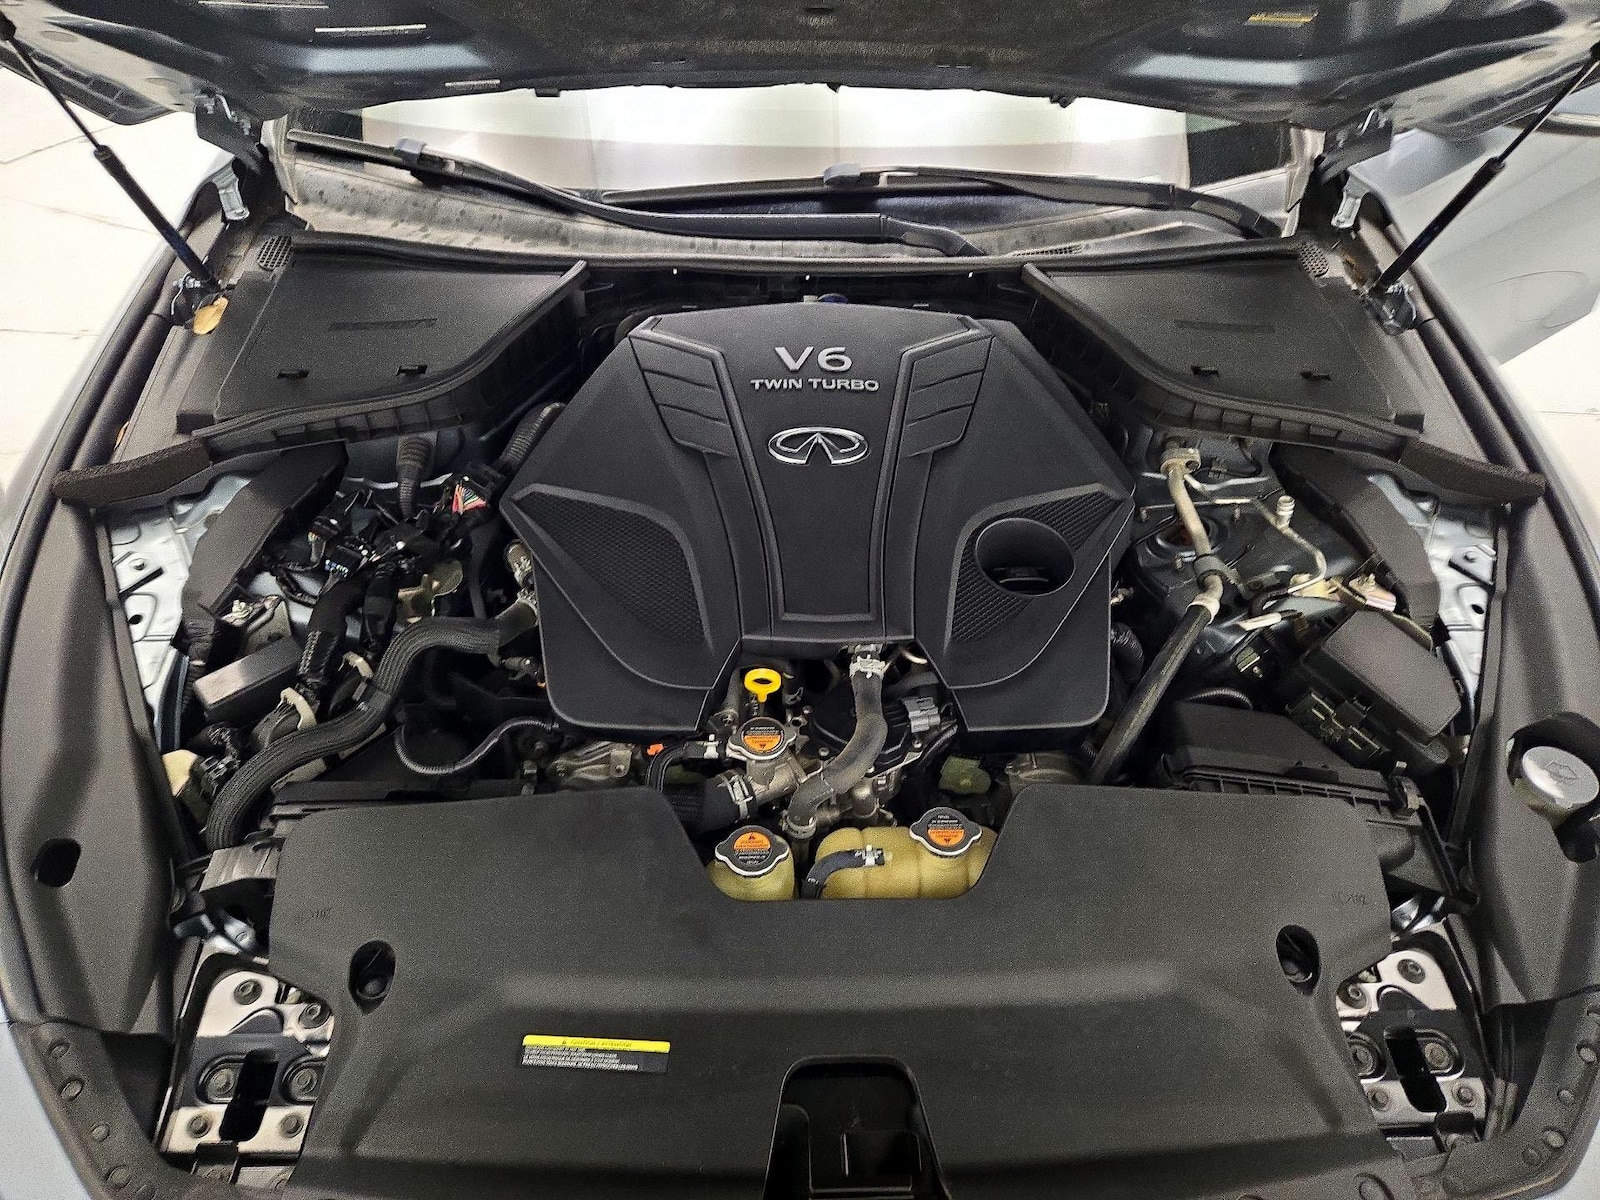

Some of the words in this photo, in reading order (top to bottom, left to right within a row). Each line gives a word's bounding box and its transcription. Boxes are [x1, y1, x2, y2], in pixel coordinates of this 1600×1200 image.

[774, 346, 853, 372] V6
[750, 378, 803, 391] TWIN
[808, 378, 880, 392] TURBO
